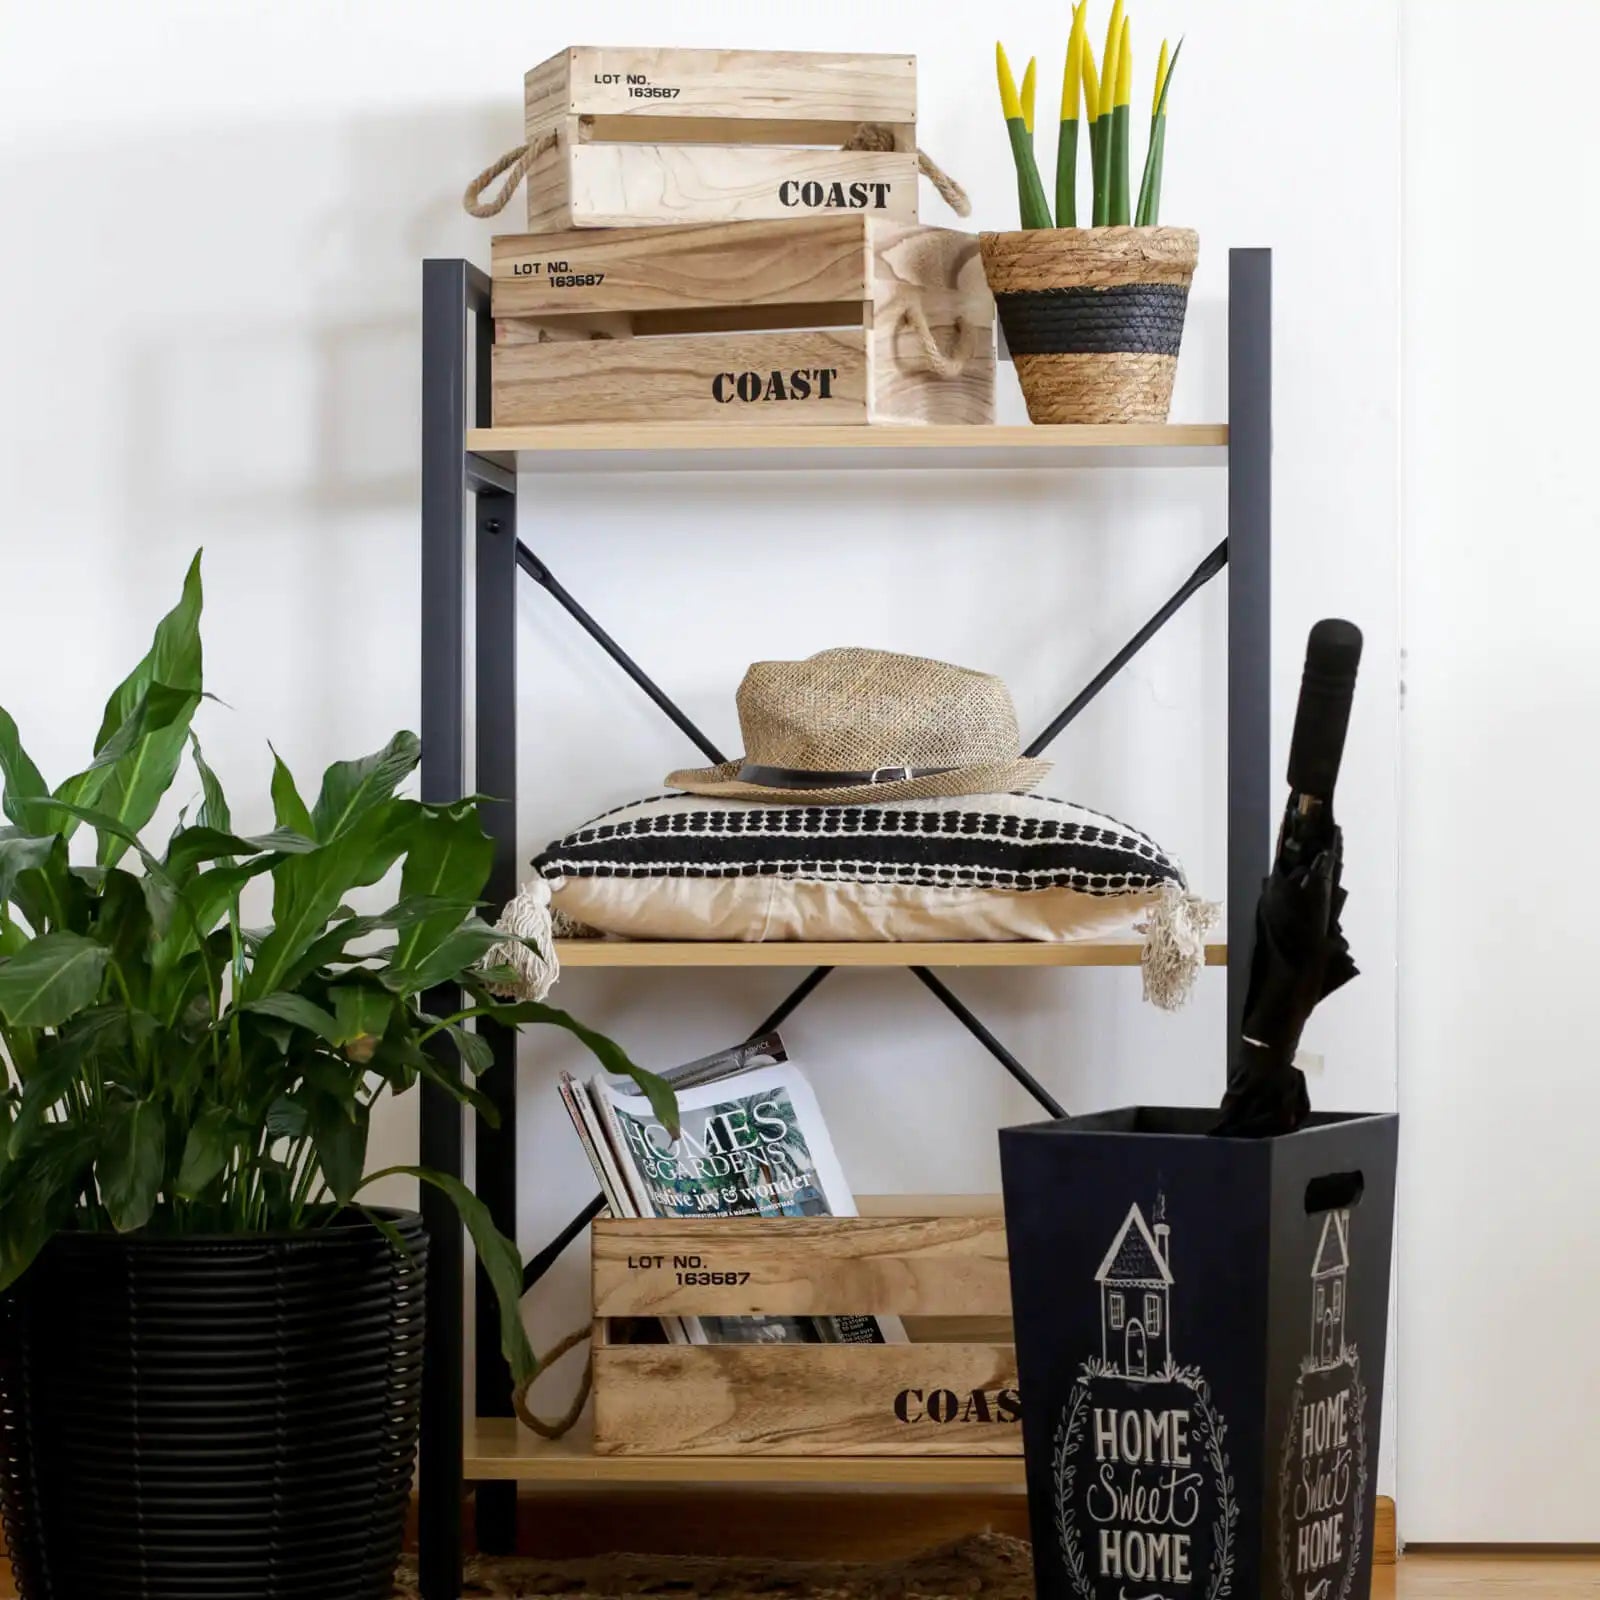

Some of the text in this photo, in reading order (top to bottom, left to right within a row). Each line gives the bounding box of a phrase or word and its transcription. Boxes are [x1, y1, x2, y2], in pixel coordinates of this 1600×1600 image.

[594, 74, 651, 86] LOT NO.
[627, 87, 681, 99] 163587
[778, 180, 891, 209] COAST
[513, 261, 573, 276] LOT NO.
[549, 274, 605, 288] 163587
[711, 368, 838, 404] COAST
[618, 1100, 788, 1161] HOMES
[693, 1188, 720, 1211] joy
[722, 1186, 740, 1204] &
[740, 1171, 812, 1201] wonder
[628, 1255, 707, 1269] LOT NO.
[674, 1272, 751, 1286] 163587
[1092, 1407, 1192, 1467] HOME
[1301, 1388, 1349, 1460] HOME
[1086, 1462, 1203, 1528] Sweet
[1100, 1528, 1192, 1584] HOME
[1297, 1512, 1344, 1575] HOME
